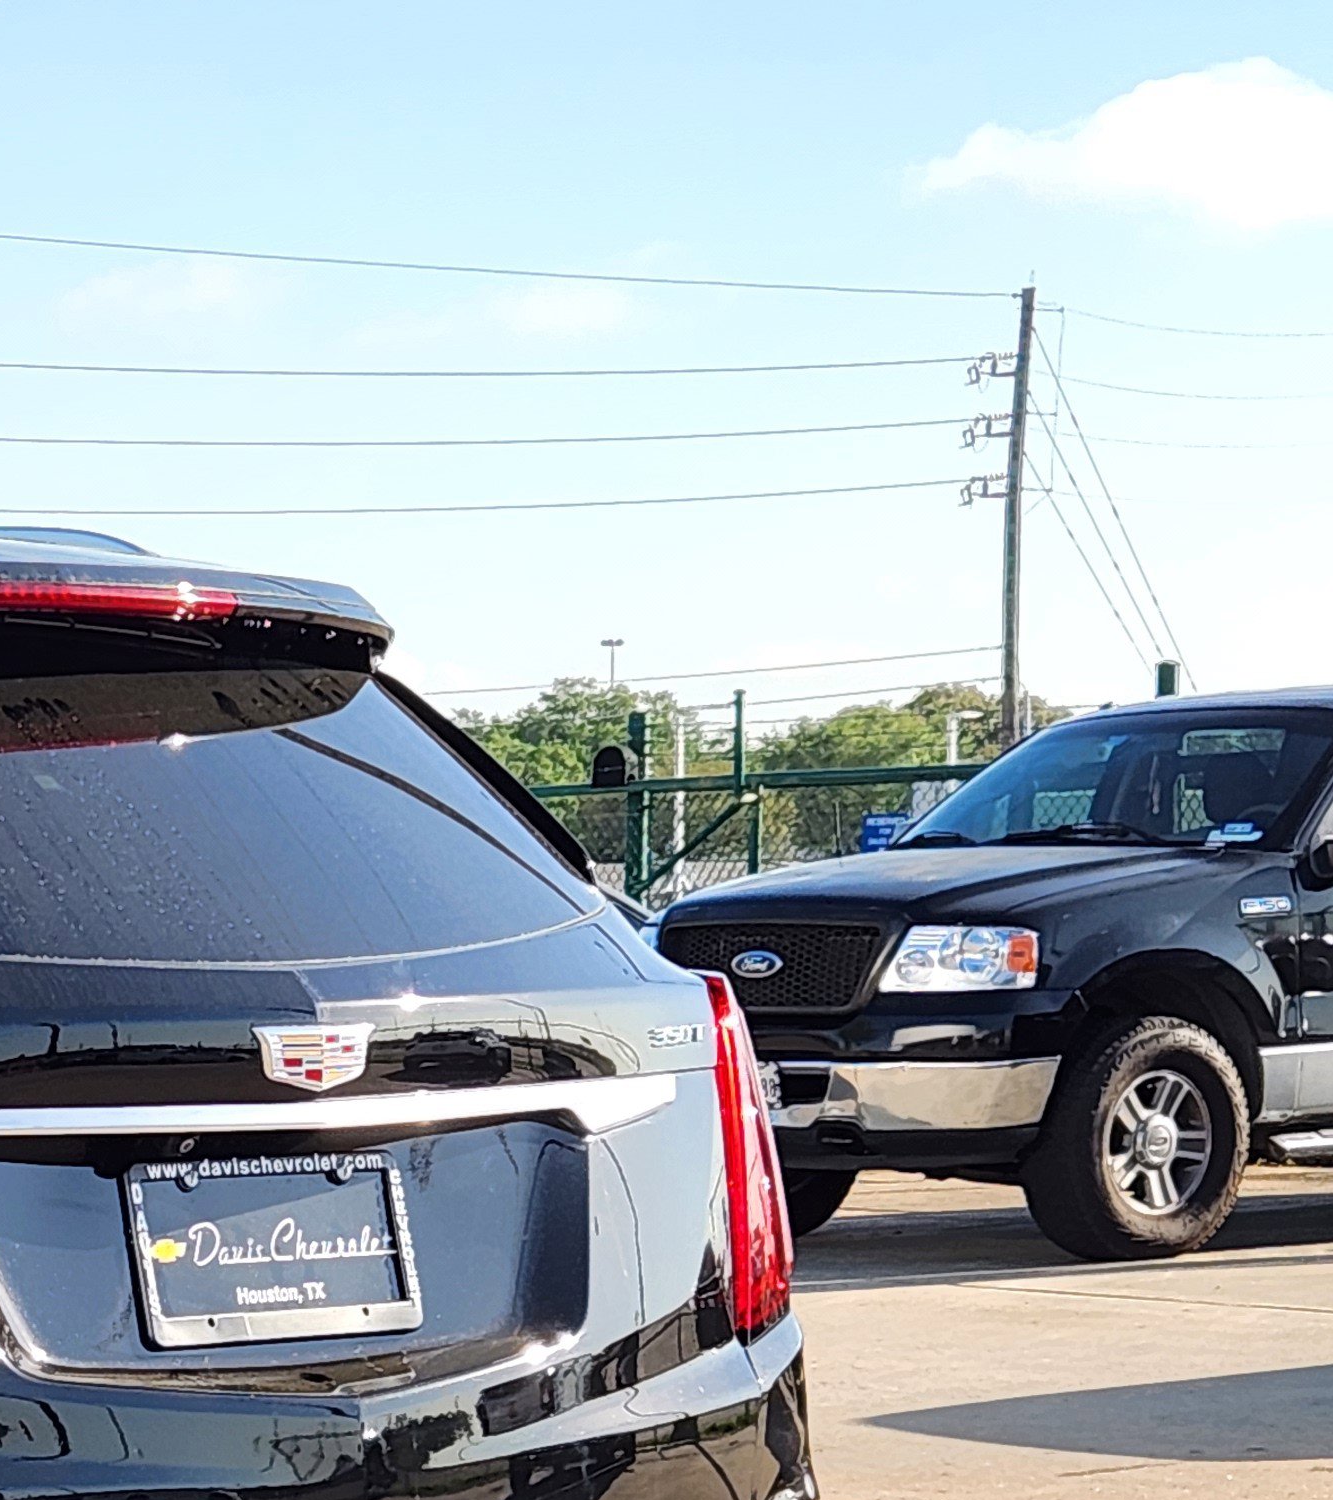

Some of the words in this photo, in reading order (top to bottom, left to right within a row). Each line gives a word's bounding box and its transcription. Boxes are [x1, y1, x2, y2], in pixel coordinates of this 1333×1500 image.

[145, 1153, 384, 1180] wwwdavischevroletcom
[188, 1221, 272, 1267] Davis
[235, 1284, 304, 1305] Houston,
[303, 1281, 327, 1301] TX
